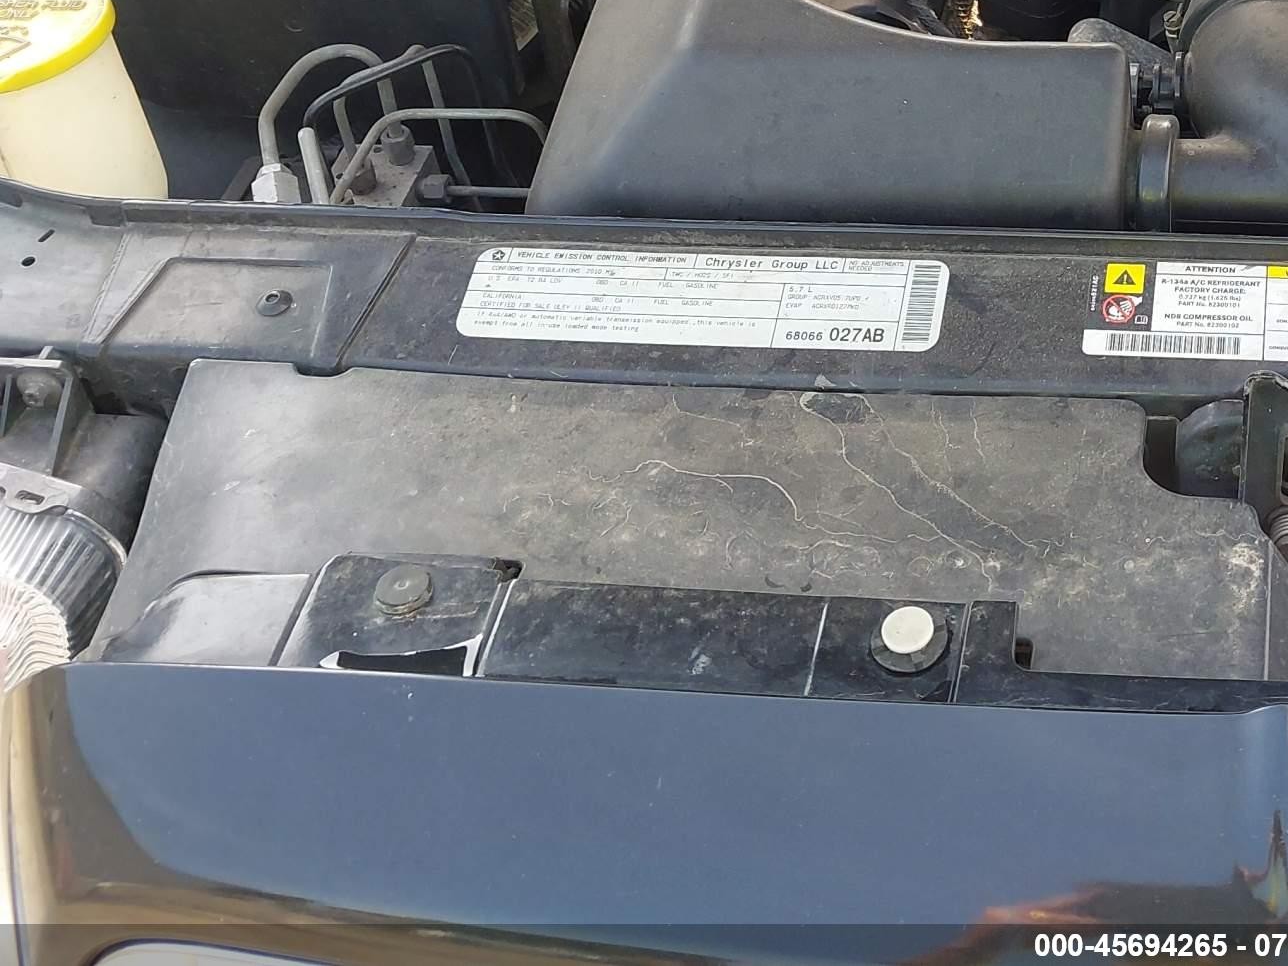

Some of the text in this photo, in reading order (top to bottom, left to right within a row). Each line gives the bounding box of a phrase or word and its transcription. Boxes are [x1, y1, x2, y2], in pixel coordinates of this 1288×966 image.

[554, 253, 592, 261] EMISSION
[597, 254, 629, 262] CONTROL
[635, 255, 686, 263] INFORMATION
[706, 257, 838, 272] Chrysler Group LLC
[785, 328, 885, 342] 68066 027AB
